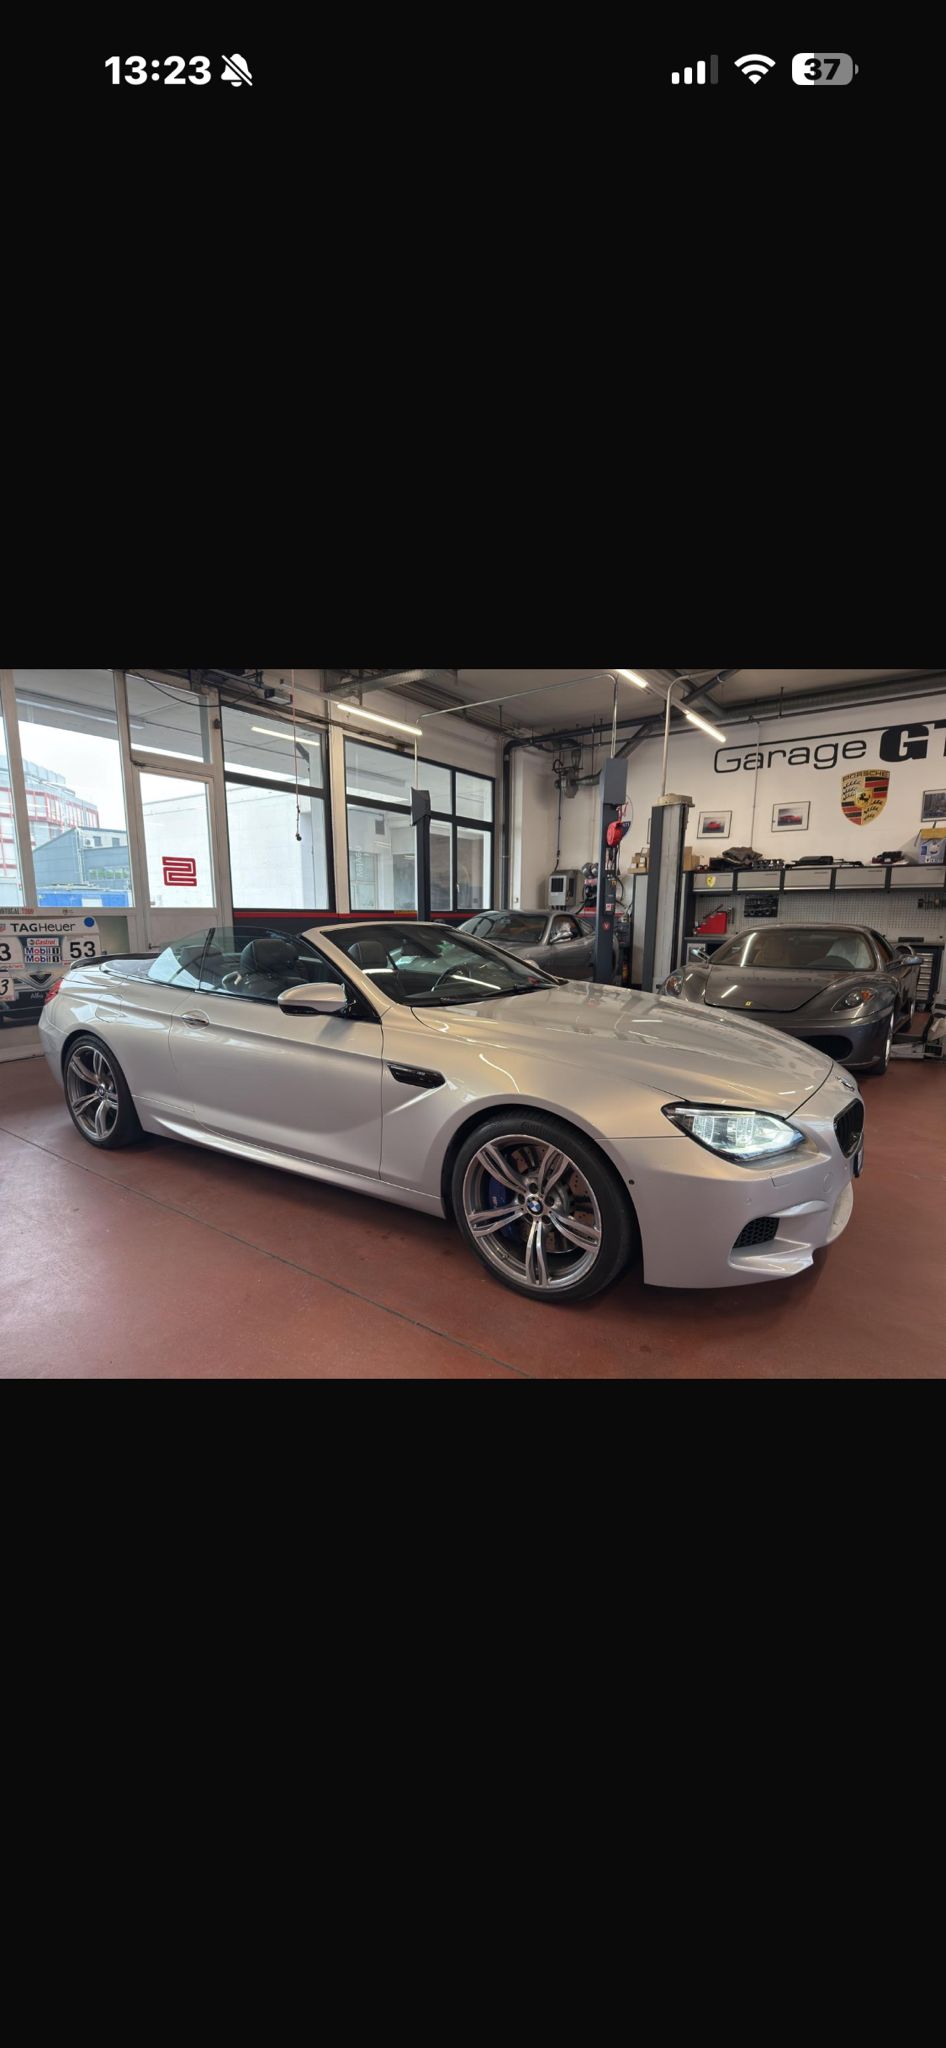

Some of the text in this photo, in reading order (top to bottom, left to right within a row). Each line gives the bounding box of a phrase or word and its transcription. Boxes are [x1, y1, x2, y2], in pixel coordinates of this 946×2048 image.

[714, 719, 946, 773] Garage G
[842, 770, 890, 781] PORSCHE
[70, 941, 96, 958] 53
